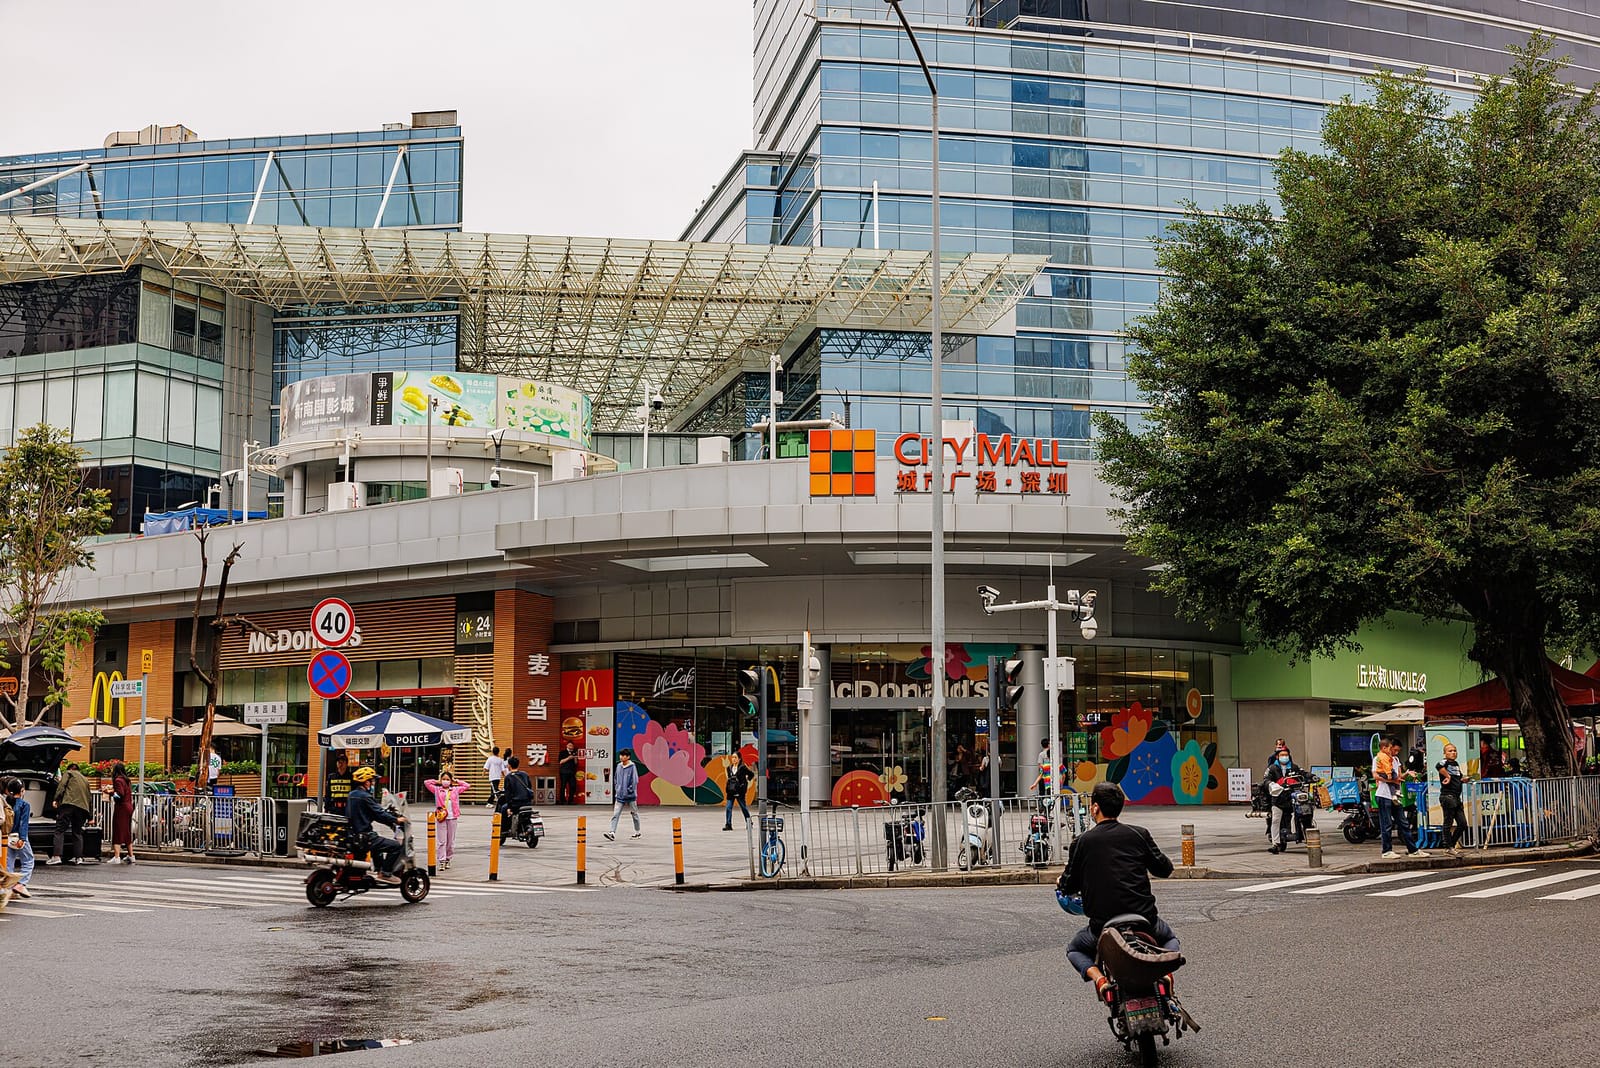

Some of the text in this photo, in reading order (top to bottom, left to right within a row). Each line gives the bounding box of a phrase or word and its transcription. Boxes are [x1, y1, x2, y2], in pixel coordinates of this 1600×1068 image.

[977, 433, 1068, 467] MALL
[320, 612, 346, 634] 40
[476, 616, 490, 631] 24
[526, 653, 550, 766] 麦当劳
[396, 735, 429, 744] POLICE
